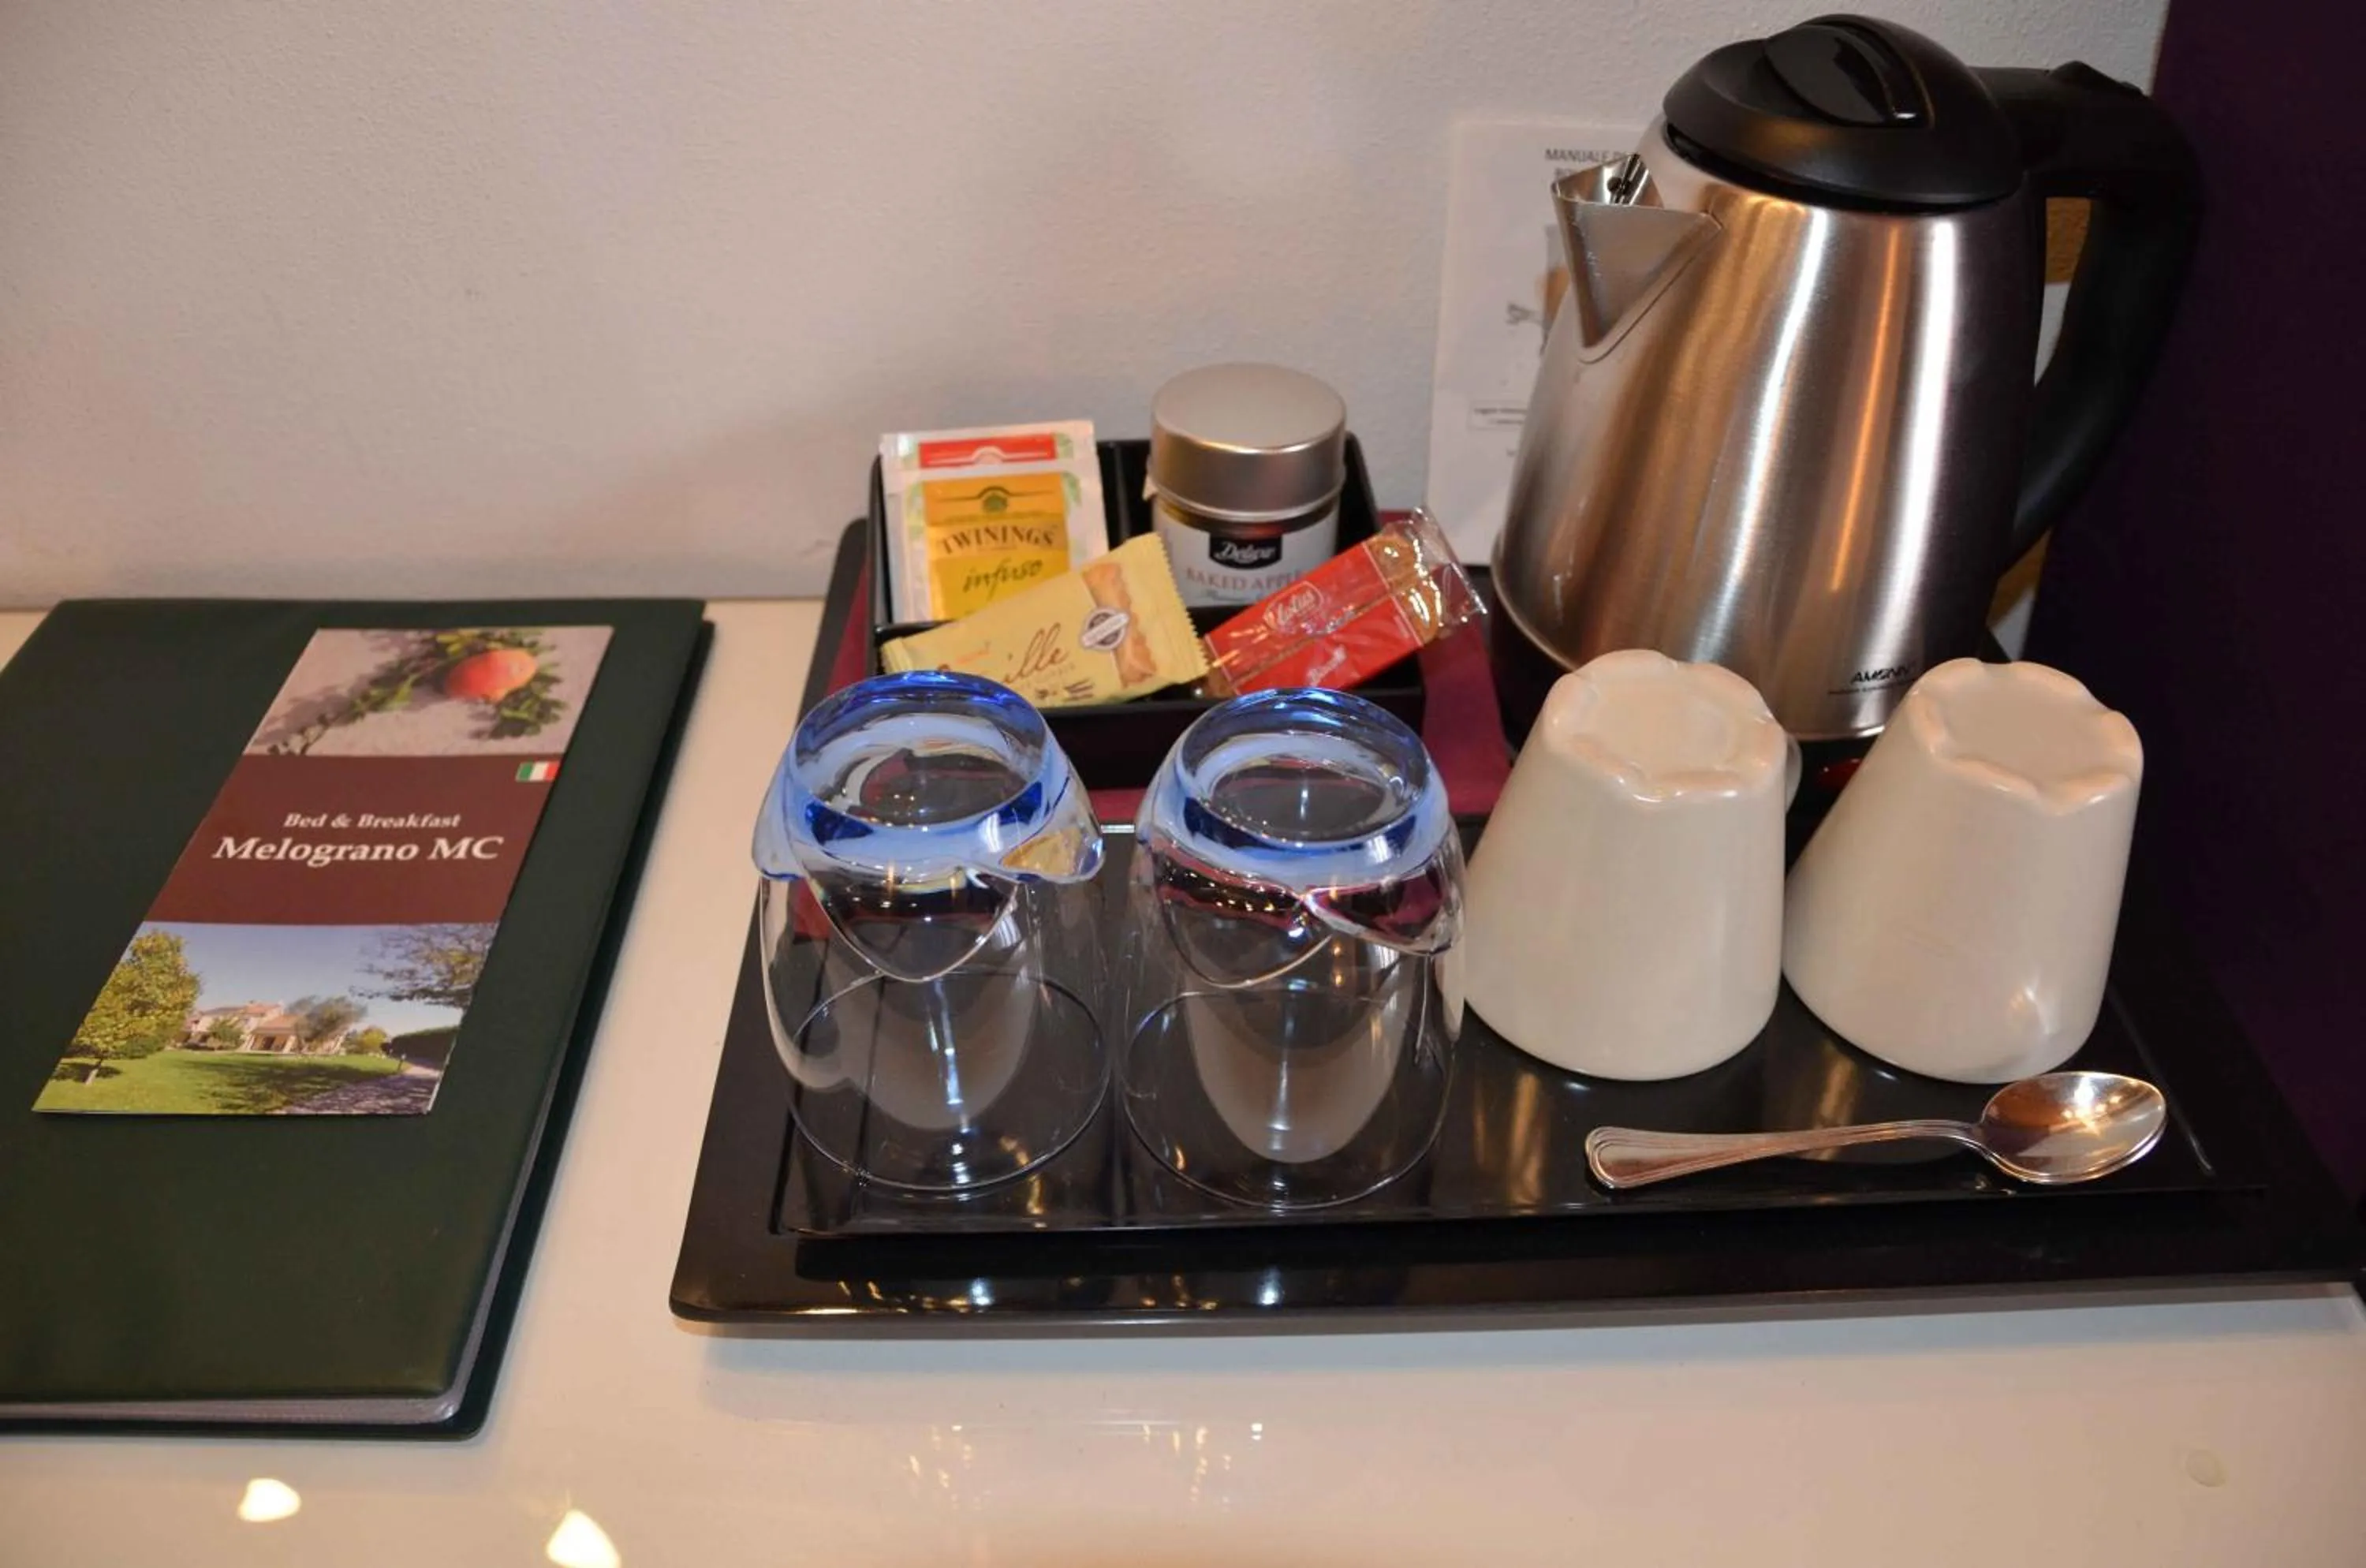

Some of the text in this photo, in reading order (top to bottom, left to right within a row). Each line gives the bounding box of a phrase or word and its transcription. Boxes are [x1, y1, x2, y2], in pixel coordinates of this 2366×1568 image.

[1545, 149, 1609, 163] MANUALE
[939, 525, 1054, 554] TWININGS
[962, 557, 1043, 601] infuso
[1185, 567, 1247, 590] BAKED
[283, 813, 461, 828] Bed & Breakfast
[212, 836, 504, 868] Melograno MC
